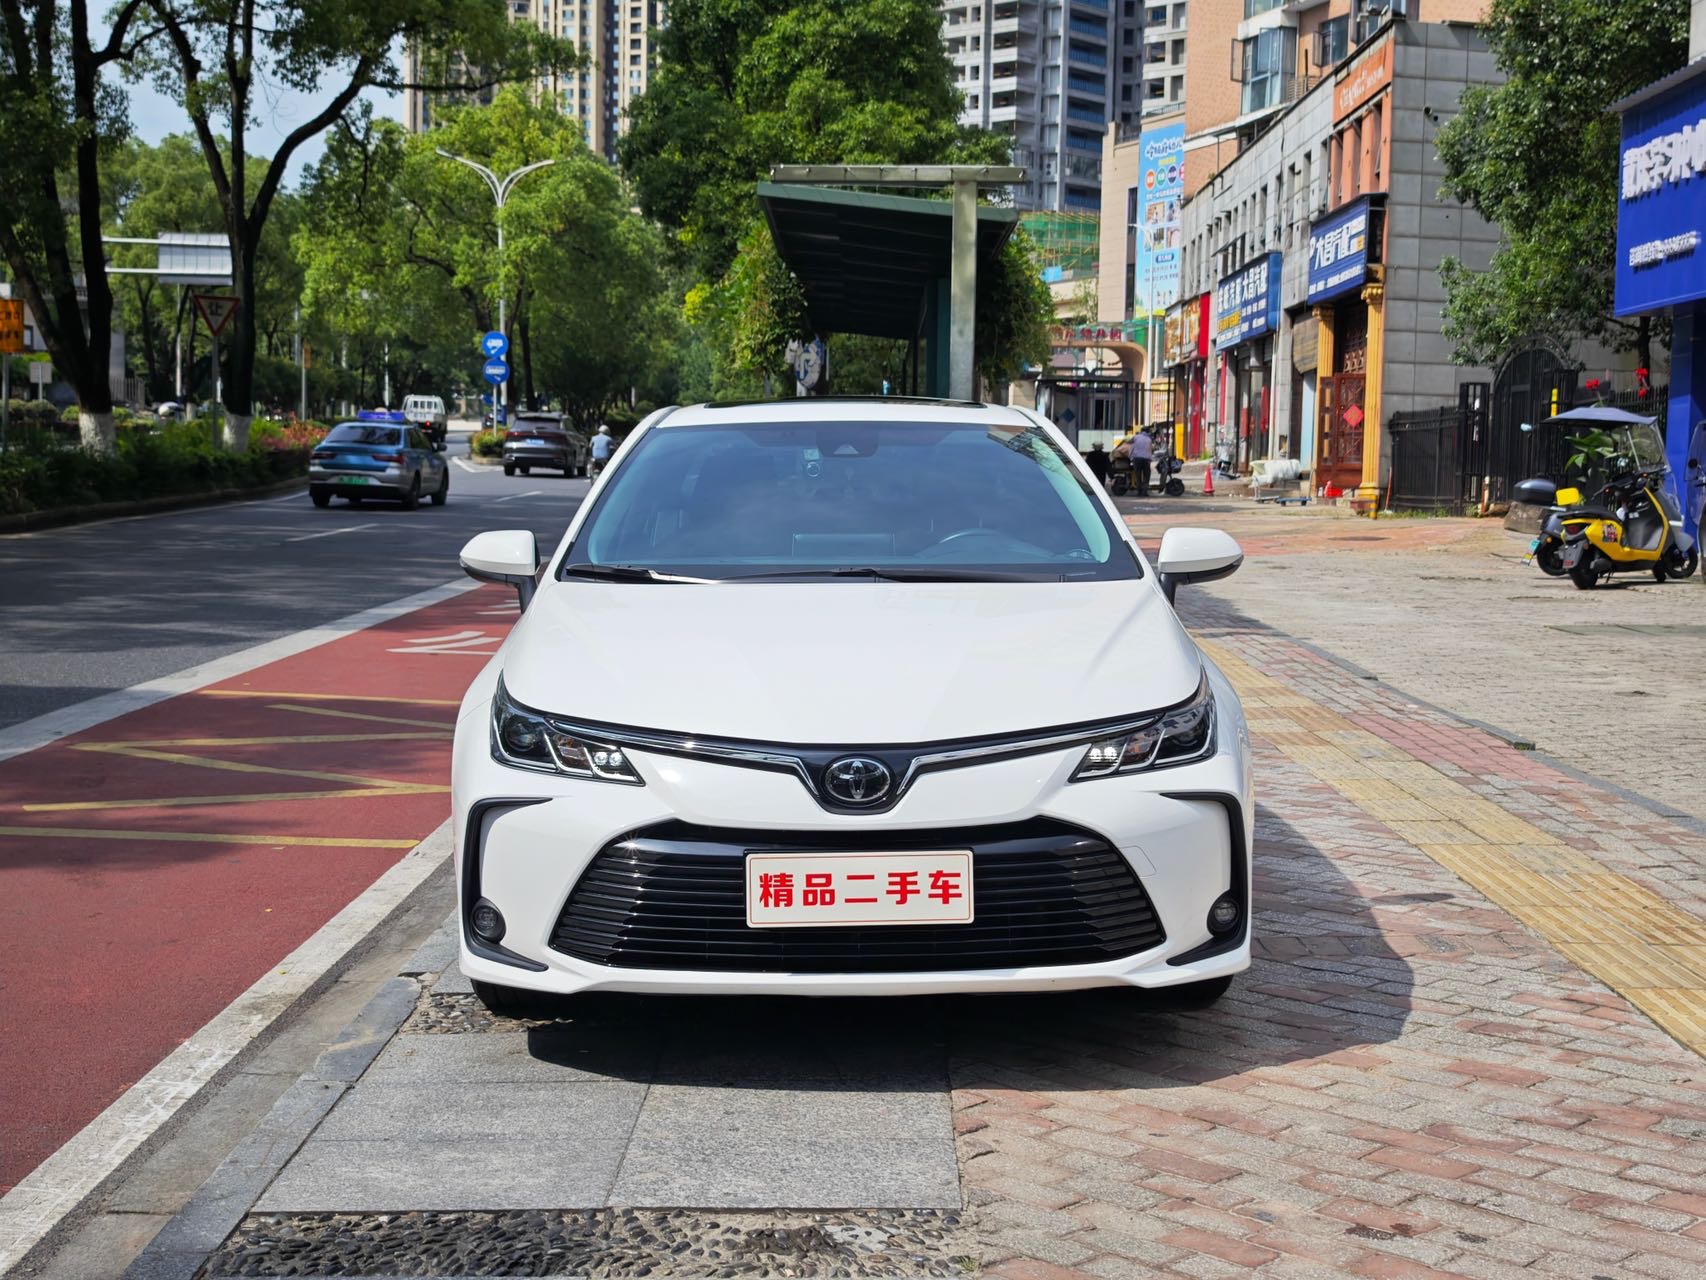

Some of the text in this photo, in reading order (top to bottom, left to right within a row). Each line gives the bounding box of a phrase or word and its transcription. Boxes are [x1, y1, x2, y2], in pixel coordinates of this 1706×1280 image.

[758, 870, 963, 908] 精品二手车
